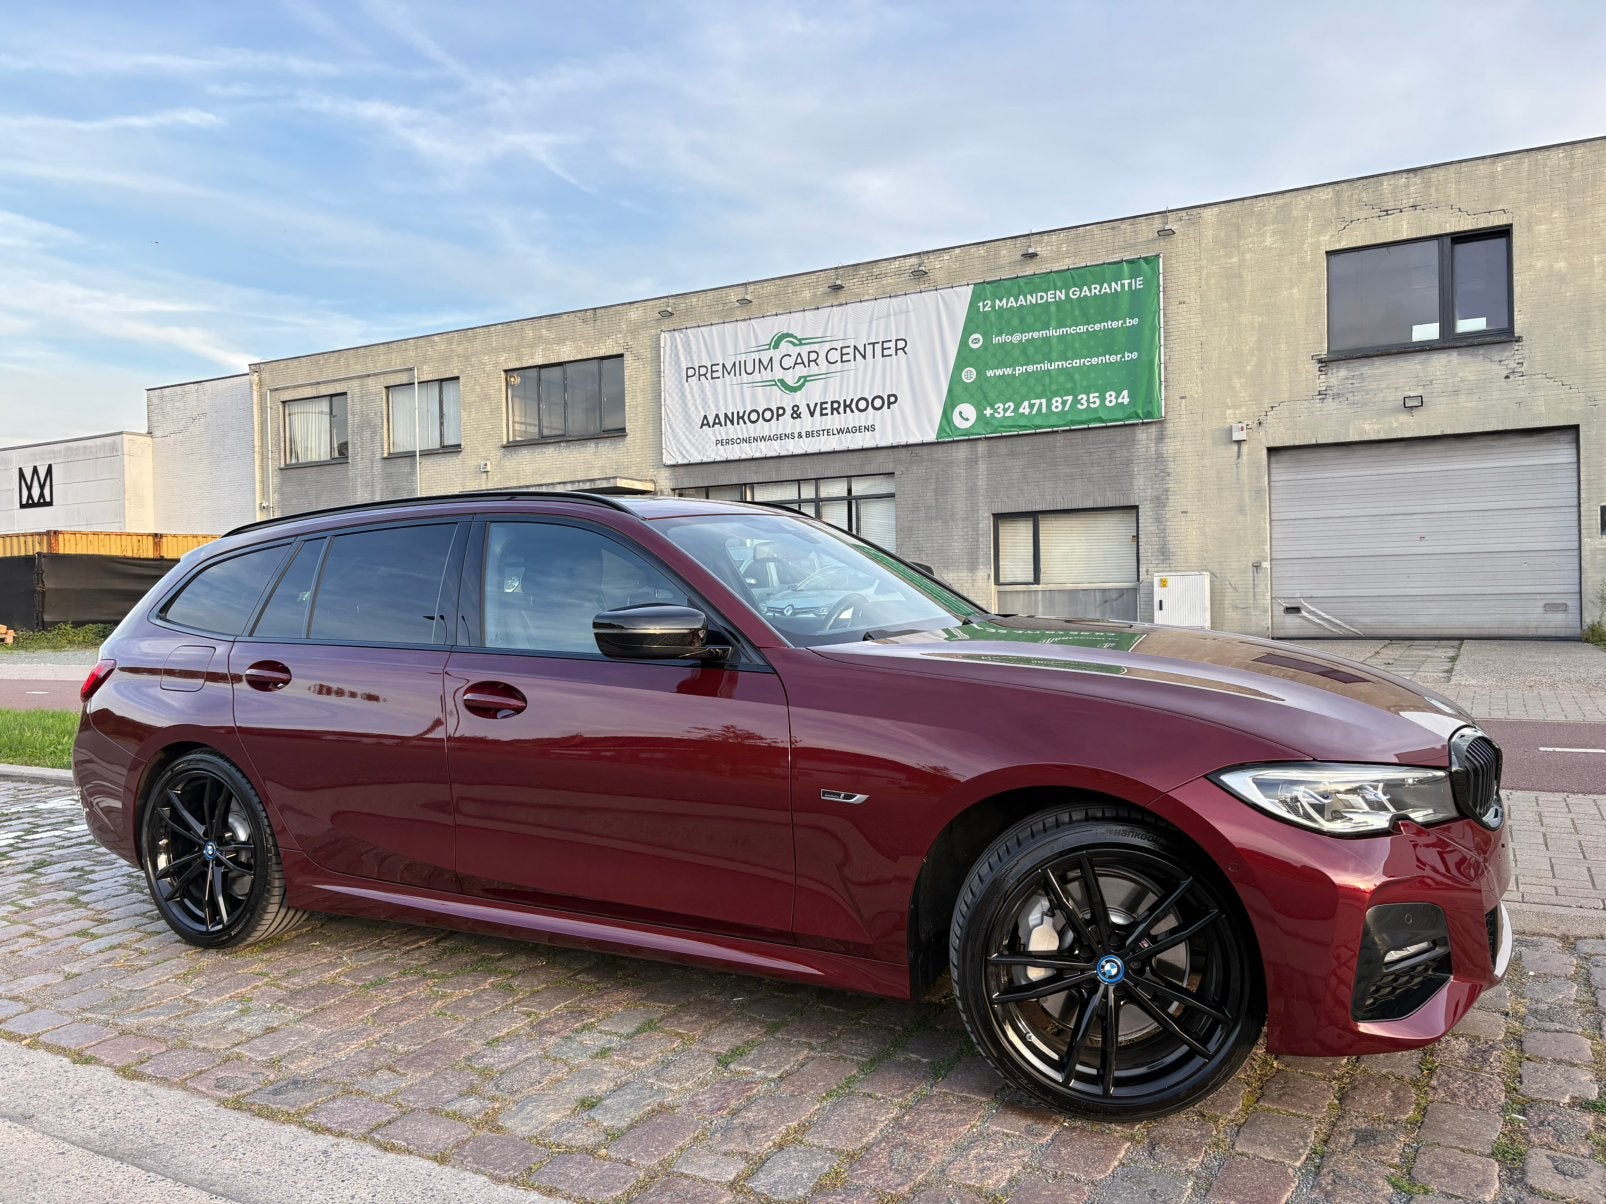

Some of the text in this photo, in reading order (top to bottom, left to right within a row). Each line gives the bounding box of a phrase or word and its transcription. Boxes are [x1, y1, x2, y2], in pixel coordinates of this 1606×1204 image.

[977, 277, 1144, 312] 12 MAANDEN GARANTIE
[992, 317, 1139, 344] info@premiumcarcenter.be
[685, 337, 908, 383] PREMIUM CAR CENTER
[986, 351, 1139, 377] www.premiumcarcenter.be
[699, 393, 899, 429] AANKOOP & VERKOOP
[983, 389, 1130, 418] +32 471 87 35 84
[715, 424, 876, 447] PERSONENWAGENS & BESTELWAGENS
